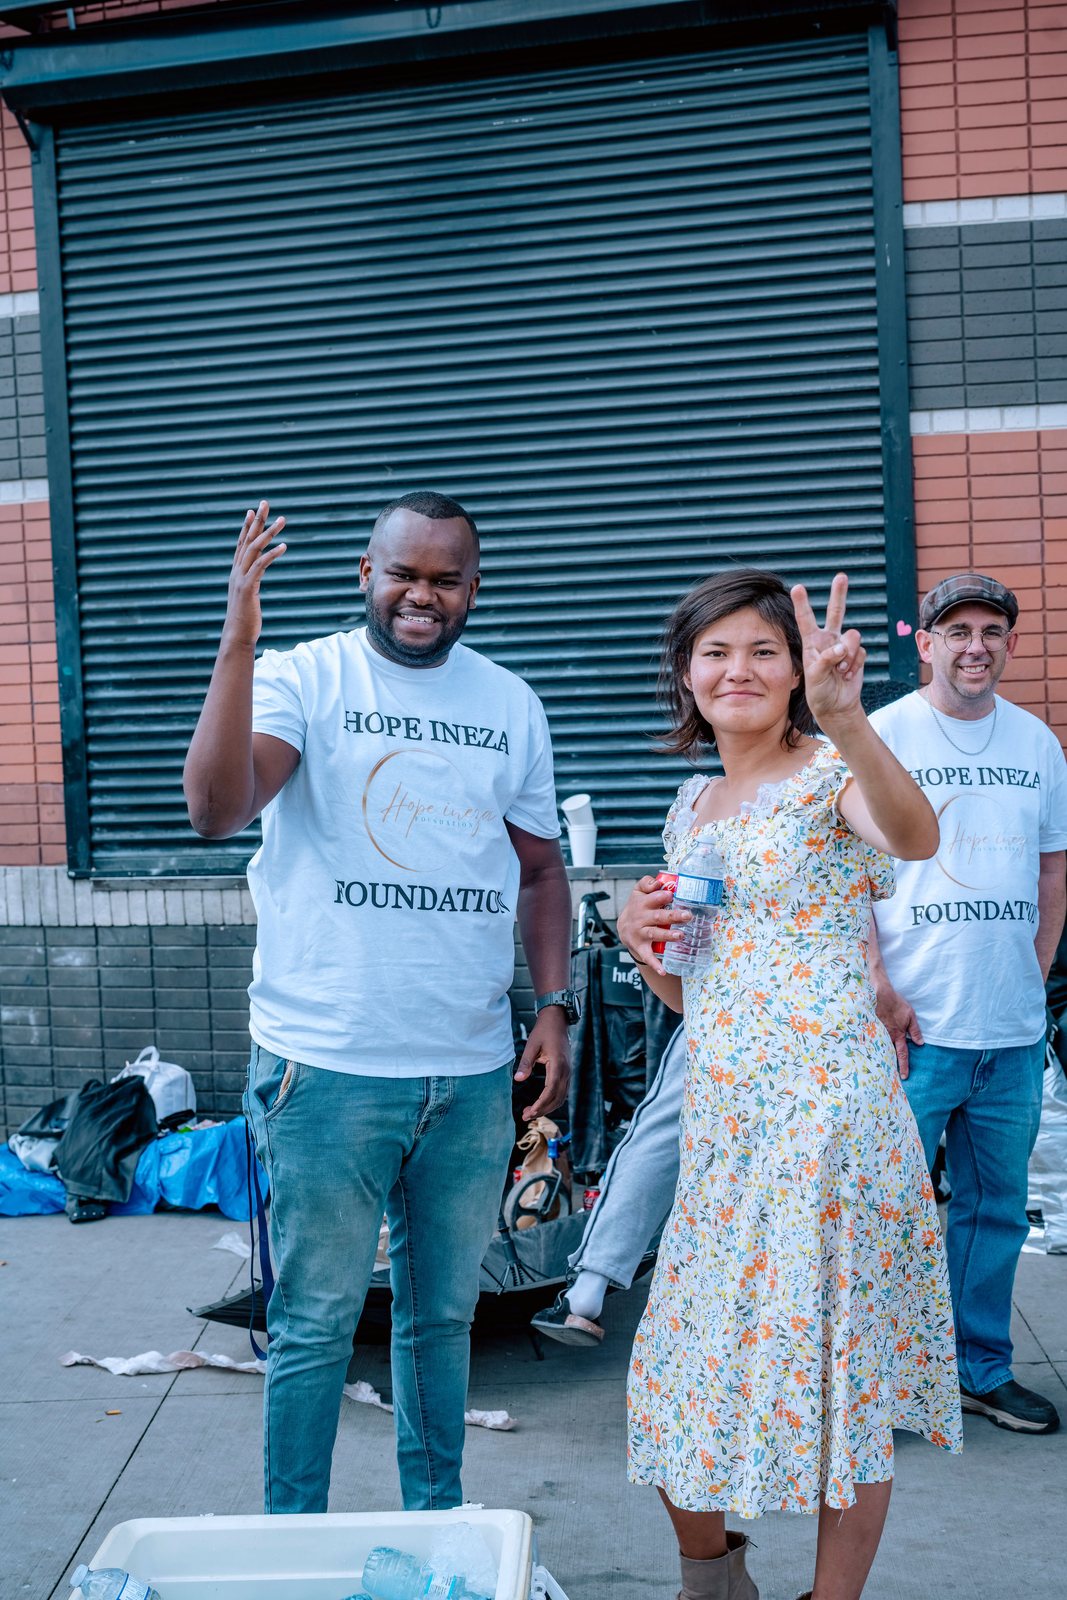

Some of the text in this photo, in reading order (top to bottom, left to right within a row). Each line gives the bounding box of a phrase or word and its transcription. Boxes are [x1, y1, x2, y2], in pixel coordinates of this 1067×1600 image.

[343, 710, 510, 756] HOPE INEZA
[908, 767, 1041, 790] HOPE INEZA
[380, 782, 434, 838] Hope
